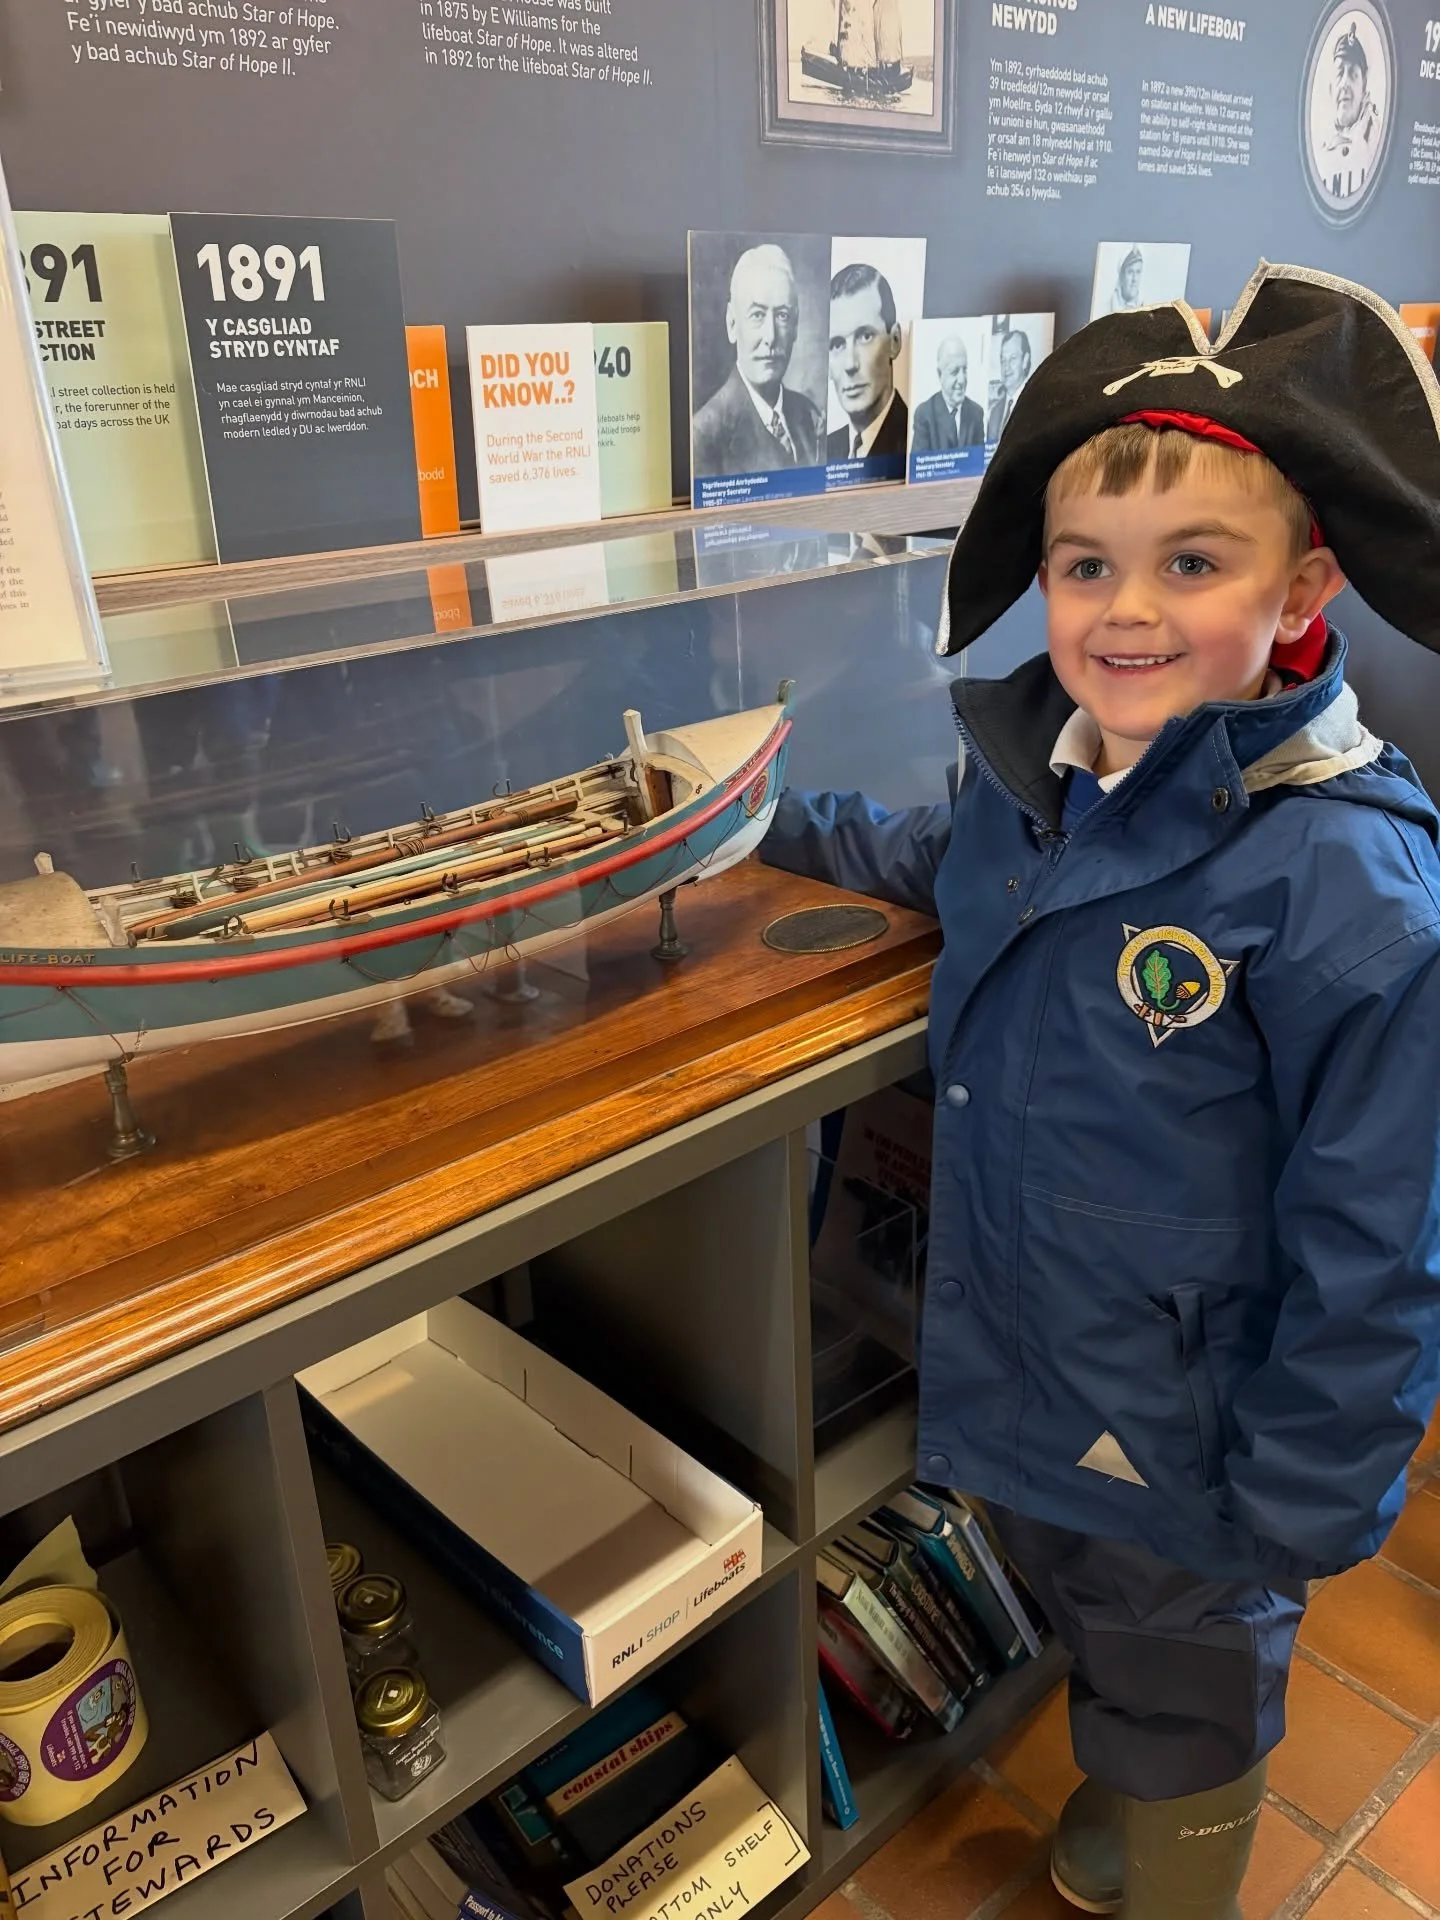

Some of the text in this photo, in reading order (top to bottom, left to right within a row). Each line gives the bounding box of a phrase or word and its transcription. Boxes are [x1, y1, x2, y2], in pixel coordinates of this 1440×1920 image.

[188, 0, 238, 20] achub
[242, 4, 275, 24] Star
[278, 7, 293, 25] of
[297, 9, 340, 32] Hope.
[420, 0, 601, 36] in 1875 by E Williams for the
[992, 3, 1058, 36] NEWYDD
[1145, 3, 1247, 42] A NEW LIFEBOAT
[106, 18, 196, 45] newidiwyd
[199, 29, 225, 47] ym
[229, 28, 267, 48] 1892
[271, 35, 289, 50] ar
[292, 35, 331, 56] gyfer
[422, 23, 638, 62] lifeboat Star of Hope. It was altered
[71, 43, 82, 64] y
[87, 41, 120, 62] bad
[125, 45, 178, 67] achub
[182, 50, 217, 70] Star
[220, 51, 235, 71] of
[239, 54, 278, 77] Hope
[425, 47, 438, 64] in
[441, 49, 474, 68] 1892
[476, 51, 496, 70] for
[498, 54, 519, 72] the
[522, 57, 569, 78] lifeboat
[571, 62, 597, 80] Star
[598, 65, 610, 81] of
[612, 66, 641, 87] Hope
[197, 243, 325, 301] 1891
[206, 317, 312, 336] Y CASGLIAD
[209, 338, 340, 359] STRYD CYNTAF
[594, 346, 631, 378] 40
[480, 351, 570, 380] DID YOU
[58, 386, 89, 397] street
[91, 384, 141, 396] collection
[142, 384, 152, 394] is
[154, 383, 176, 394] held
[216, 377, 366, 395] Mae casgliad stryd cyntaf yr RNLI
[218, 393, 365, 411] yn cael ei gynnal ym Manceinion,
[482, 380, 576, 409] KNOW..?
[65, 402, 82, 413] the
[84, 401, 141, 412] forerunner
[142, 400, 153, 410] of
[154, 399, 170, 410] the
[221, 405, 383, 425] rhagflaenydd y diwrnodau bad achub
[626, 412, 641, 423] help
[74, 418, 98, 431] days
[101, 417, 134, 427] across
[136, 416, 153, 426] the
[154, 414, 170, 425] UK
[223, 428, 261, 439] modern
[262, 425, 291, 437] ledled
[291, 427, 298, 438] y
[299, 424, 313, 435] DU
[314, 424, 325, 434] ac
[486, 428, 584, 449] During the Second
[487, 444, 591, 466] World War the RNLI
[489, 466, 578, 485] saved 6,376 lives.
[0, 953, 95, 964] LIFE-BOAT
[612, 1562, 746, 1669] RNLI SHOP Lifeboats
[562, 1748, 628, 1803] coastal
[629, 1721, 673, 1757] ships
[11, 1739, 258, 1910] INFORMATION
[103, 1831, 180, 1886] FOR
[585, 1801, 707, 1906] DONATIONS
[724, 1820, 774, 1868] SHELF
[67, 1807, 275, 1920] TEWARDS
[606, 1852, 679, 1914] PLEASE
[465, 1895, 490, 1918] Passport
